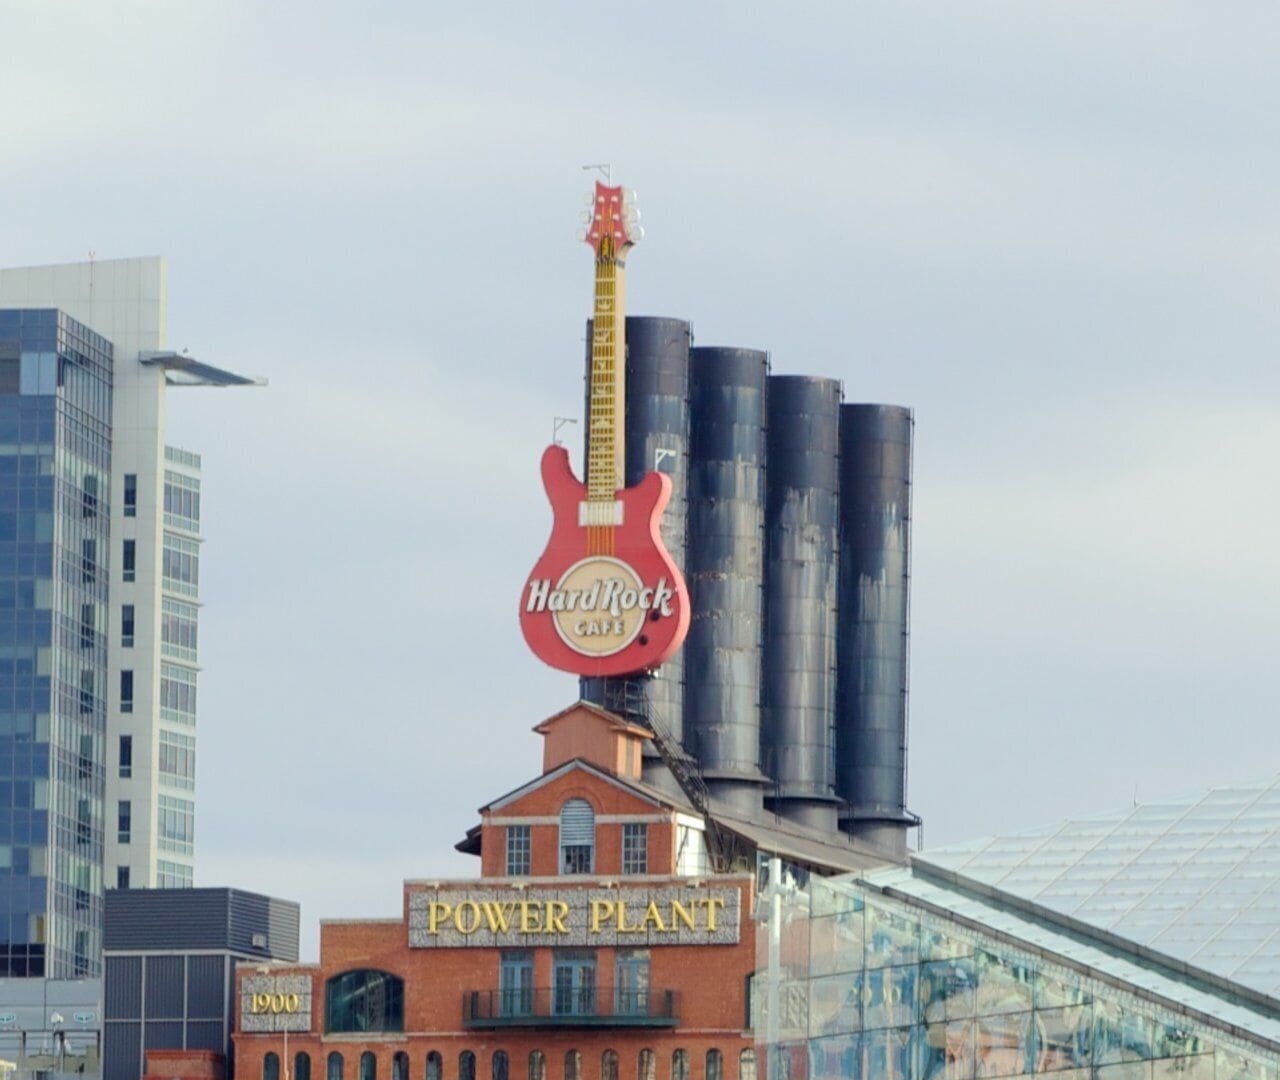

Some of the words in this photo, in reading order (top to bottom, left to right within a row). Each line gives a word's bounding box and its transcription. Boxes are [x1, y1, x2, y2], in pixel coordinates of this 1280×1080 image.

[526, 577, 600, 613] Hard
[601, 576, 674, 617] Rock
[574, 619, 625, 636] CAFE
[427, 900, 570, 935] POWER
[590, 897, 725, 933] PLANT
[251, 992, 299, 1014] 1900
